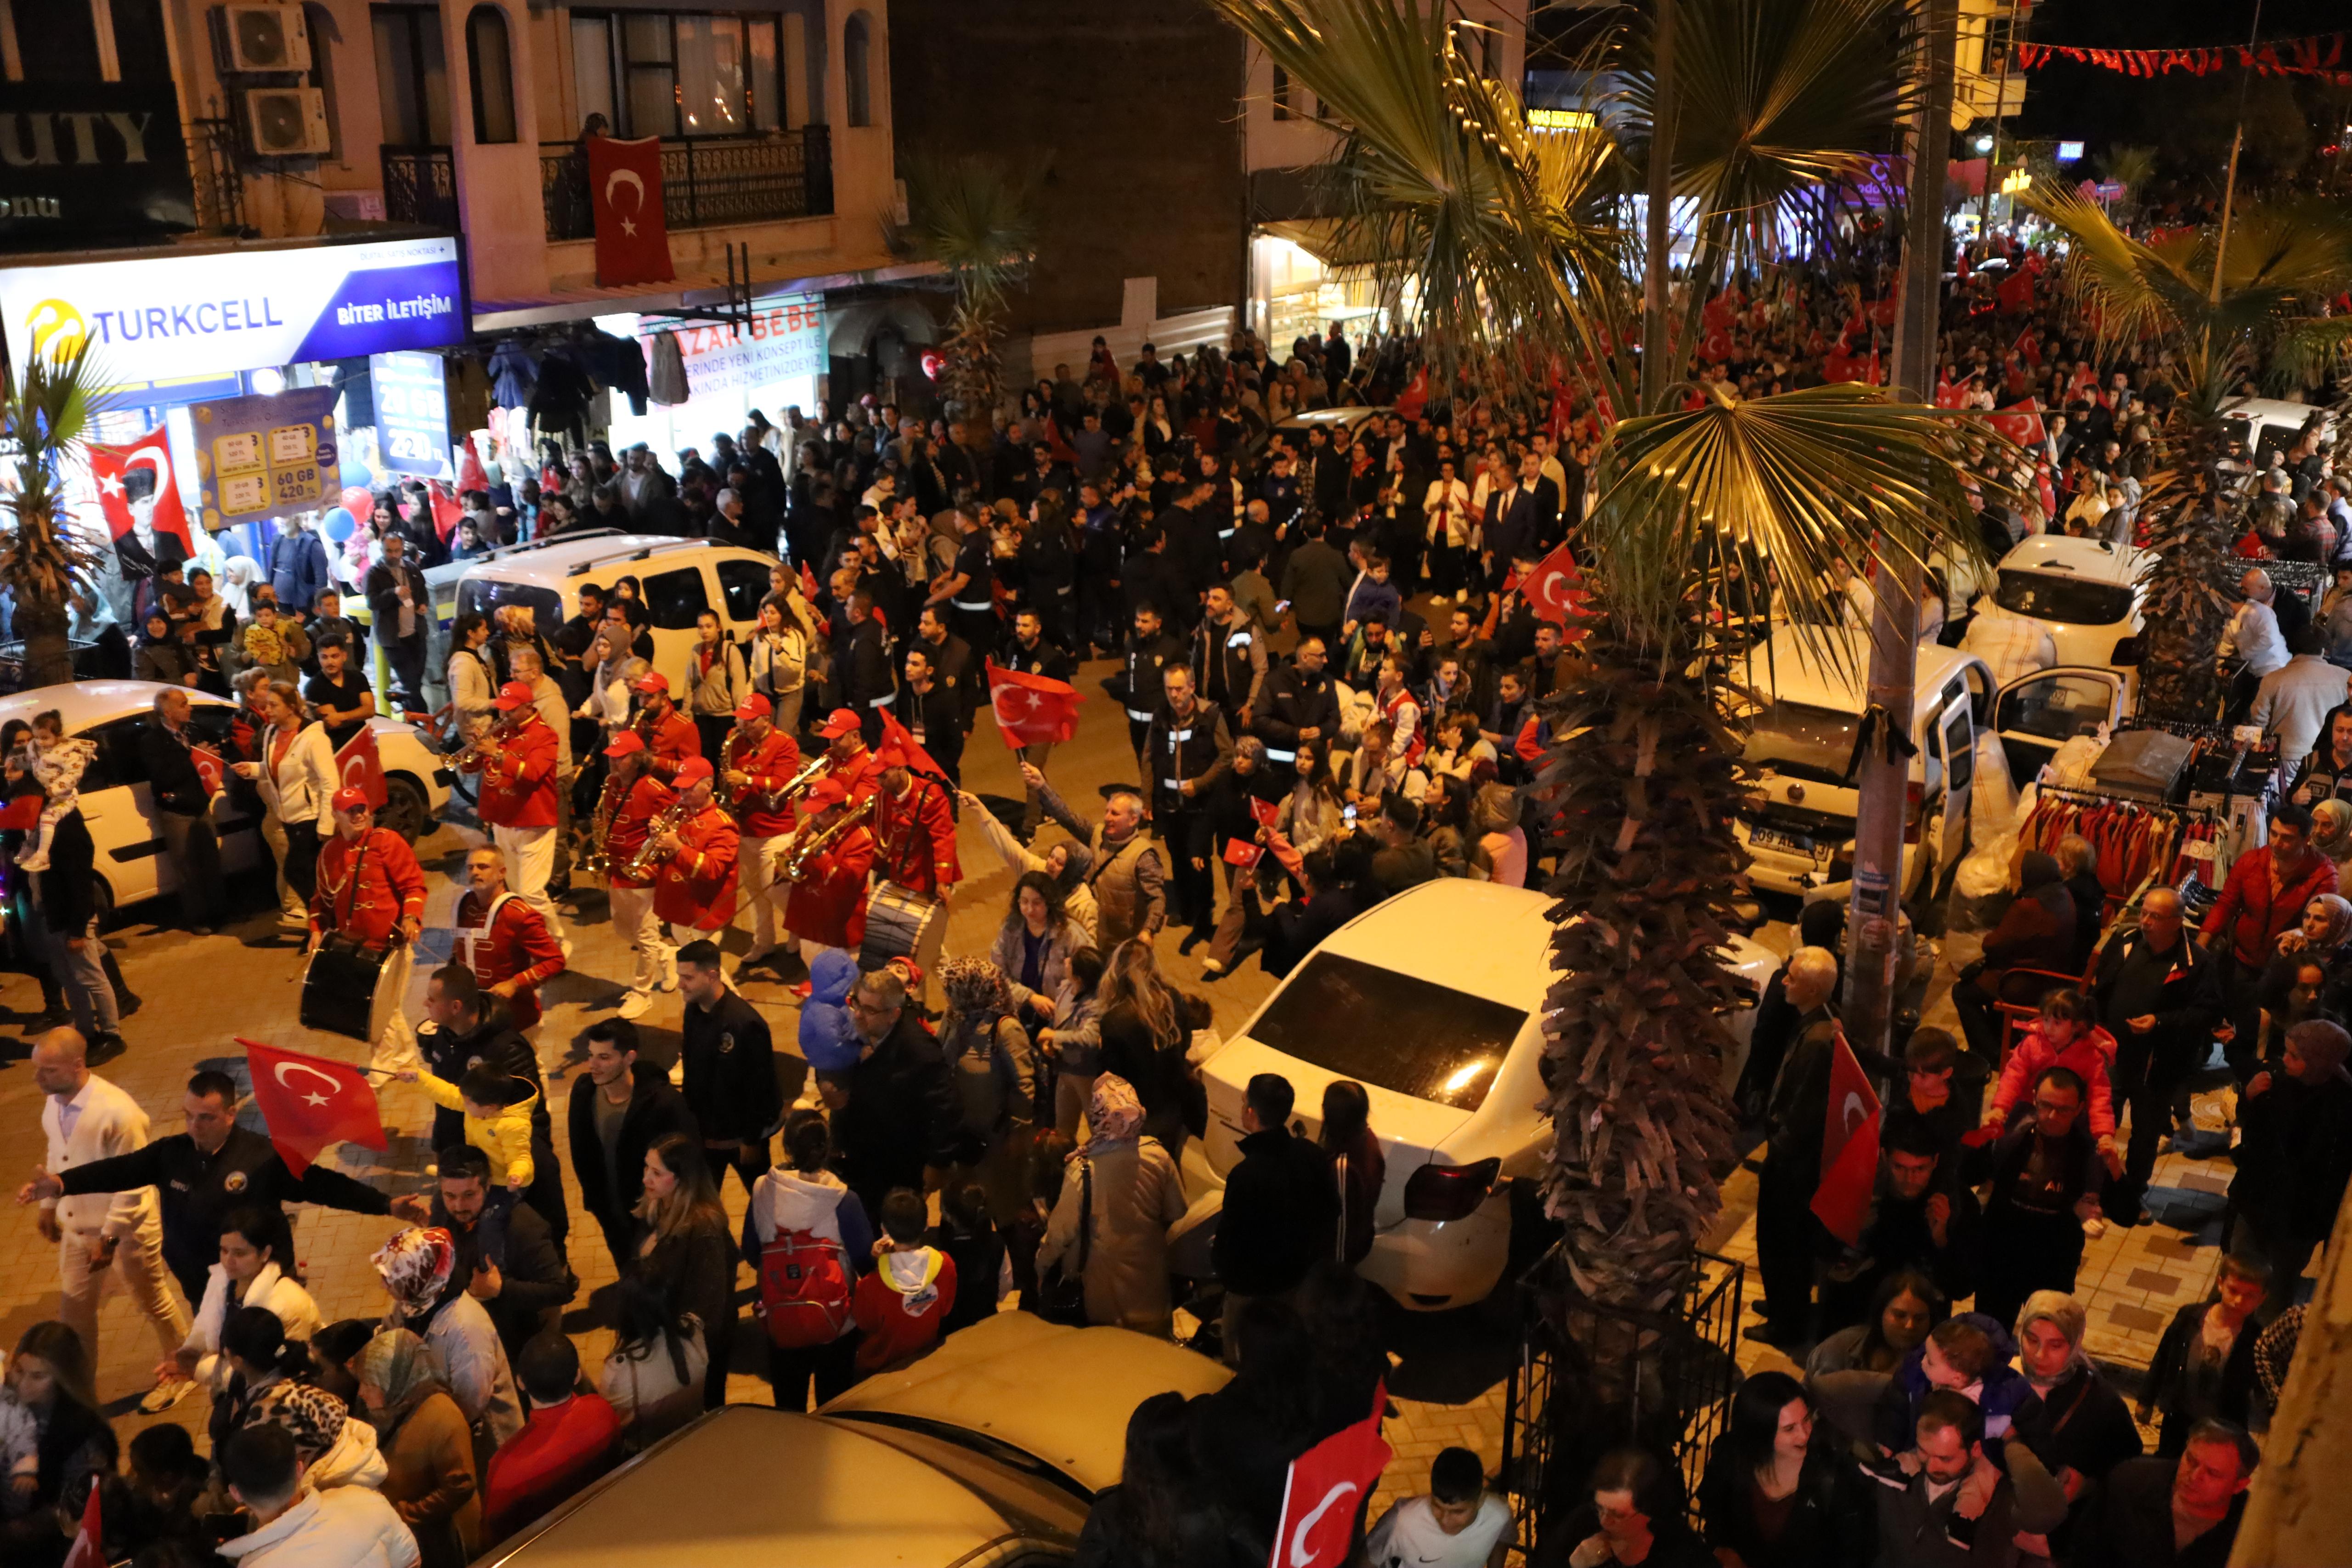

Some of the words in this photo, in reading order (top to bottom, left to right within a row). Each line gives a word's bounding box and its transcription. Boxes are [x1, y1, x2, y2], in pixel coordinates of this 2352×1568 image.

[407, 247, 436, 256] NOKTASI
[92, 297, 283, 344] TURKCELL
[337, 302, 384, 326] BİTER
[386, 293, 452, 320] İLETİŞİM
[752, 302, 820, 342] BEBE
[729, 347, 754, 368] YENİ
[757, 338, 803, 362] KONSEPT
[277, 472, 293, 486] 60
[297, 468, 315, 482] GB
[280, 484, 304, 498] 420
[1758, 829, 1774, 843] 09
